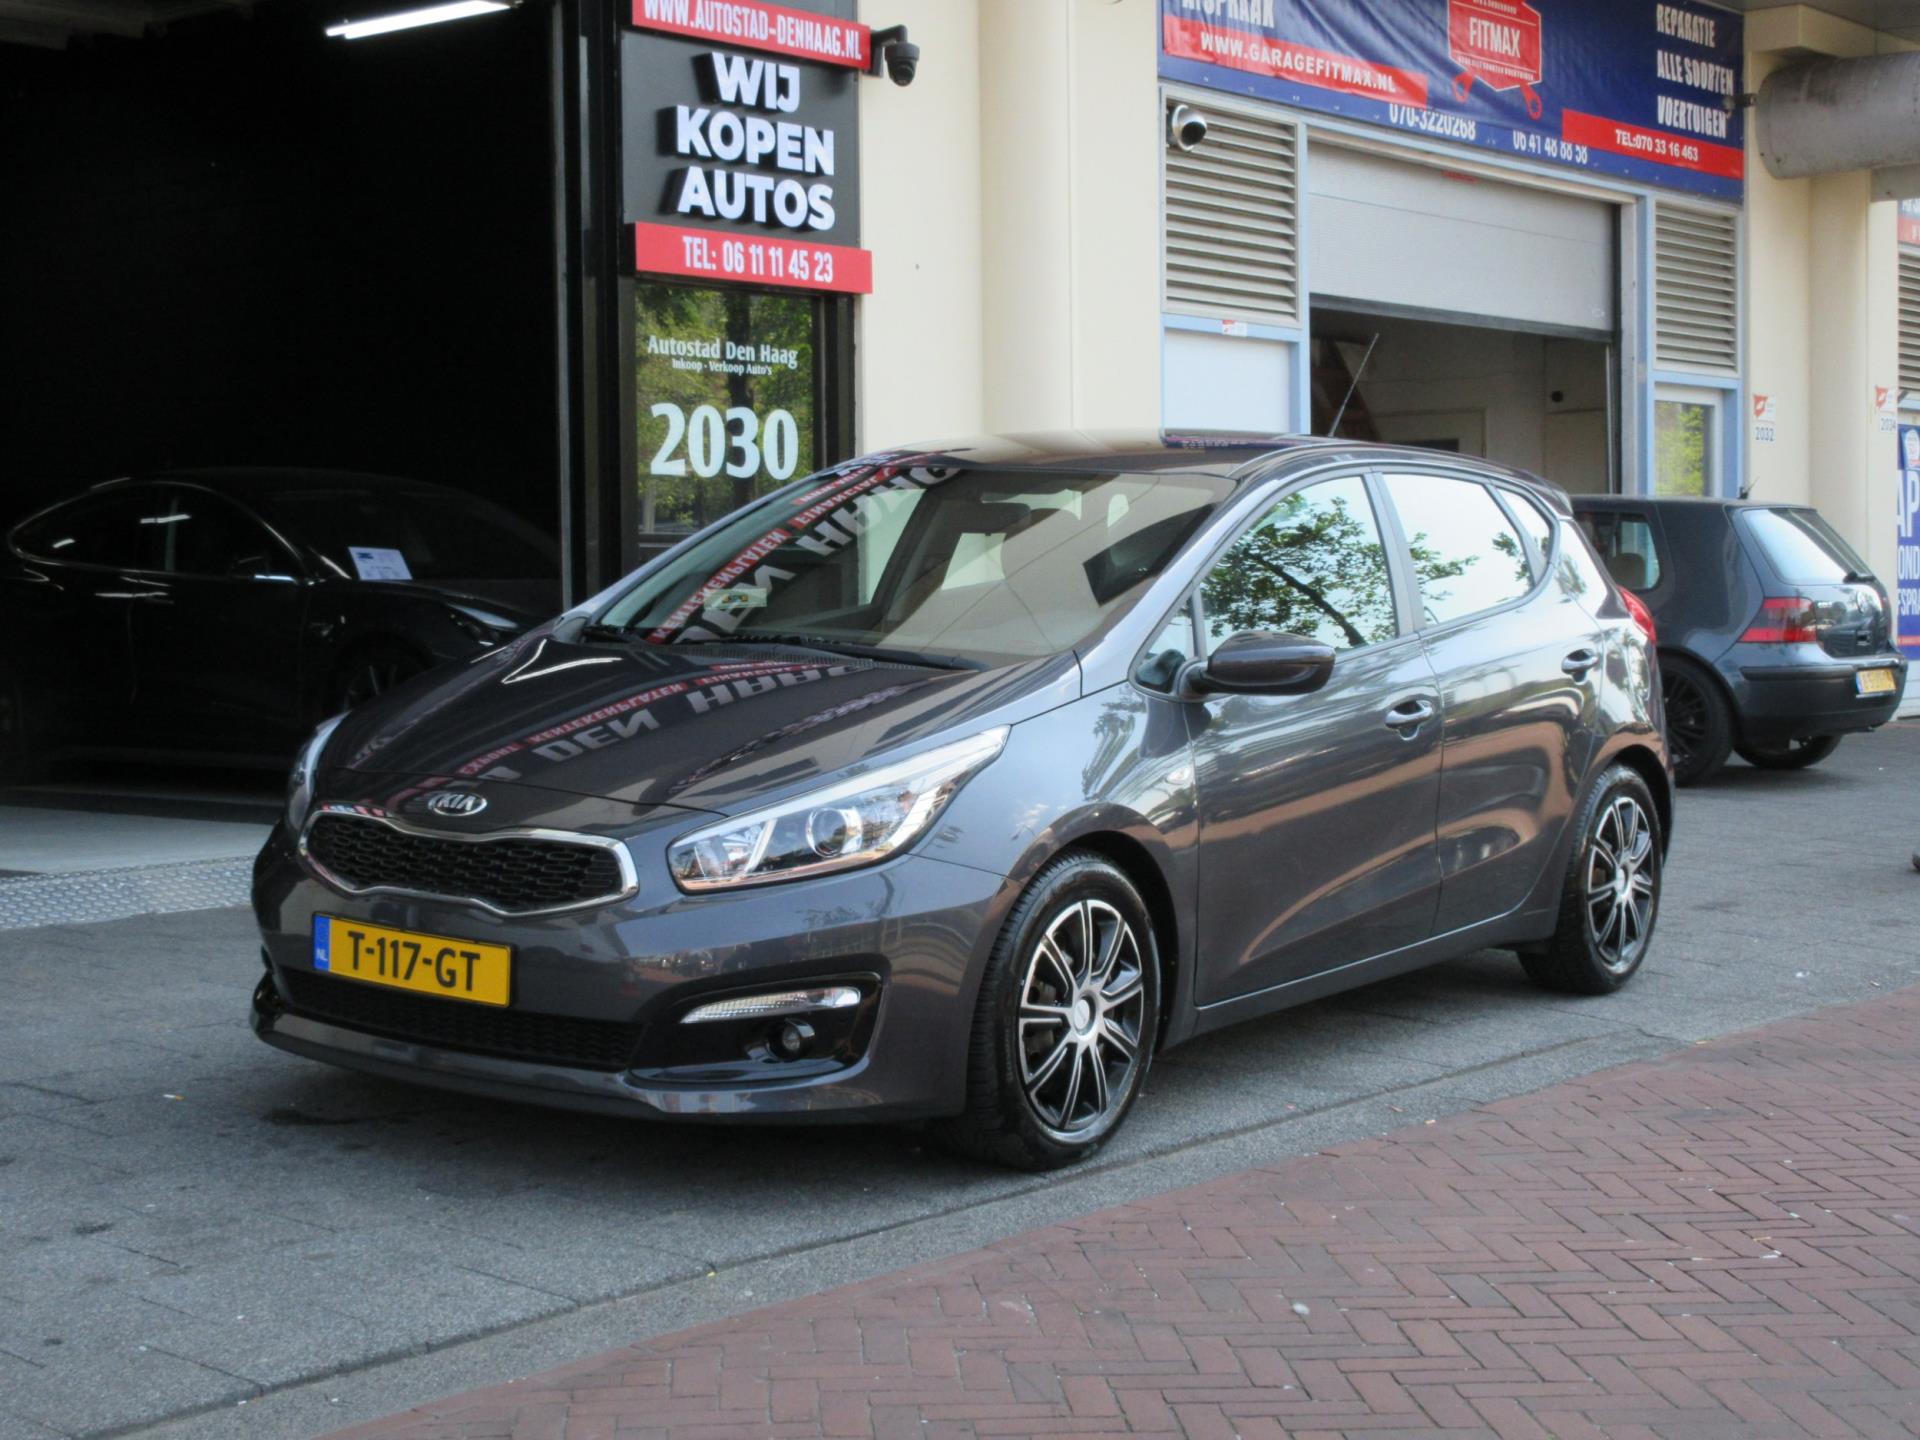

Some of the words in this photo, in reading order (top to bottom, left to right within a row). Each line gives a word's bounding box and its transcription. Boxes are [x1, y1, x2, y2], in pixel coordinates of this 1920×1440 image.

[643, 0, 862, 61] WWW.AUTOSTAD-DENHAAG.NL
[1469, 16, 1521, 58] FITMAX
[1656, 3, 1715, 48] REPARATIE
[711, 51, 801, 113] WIJ
[1200, 31, 1397, 93] WWW.GARAGEFITMAX.NL
[1656, 49, 1683, 83] ALLE
[1684, 57, 1734, 96] SOORTEN
[676, 104, 835, 177] KOPEN
[1657, 95, 1727, 139] VOERTUIGEN
[676, 165, 836, 231] AUTOS
[682, 235, 717, 271] TEL:
[722, 240, 745, 273] 06
[788, 248, 810, 281] 45
[813, 251, 834, 284] 23
[647, 334, 721, 359] Autostad
[725, 340, 756, 362] Den
[760, 343, 799, 370] Haag
[709, 361, 745, 376] Verkoop
[650, 402, 799, 480] 2030
[1755, 426, 1775, 442] 2032
[436, 793, 475, 811] KIA
[346, 930, 481, 992] T-117-GT
